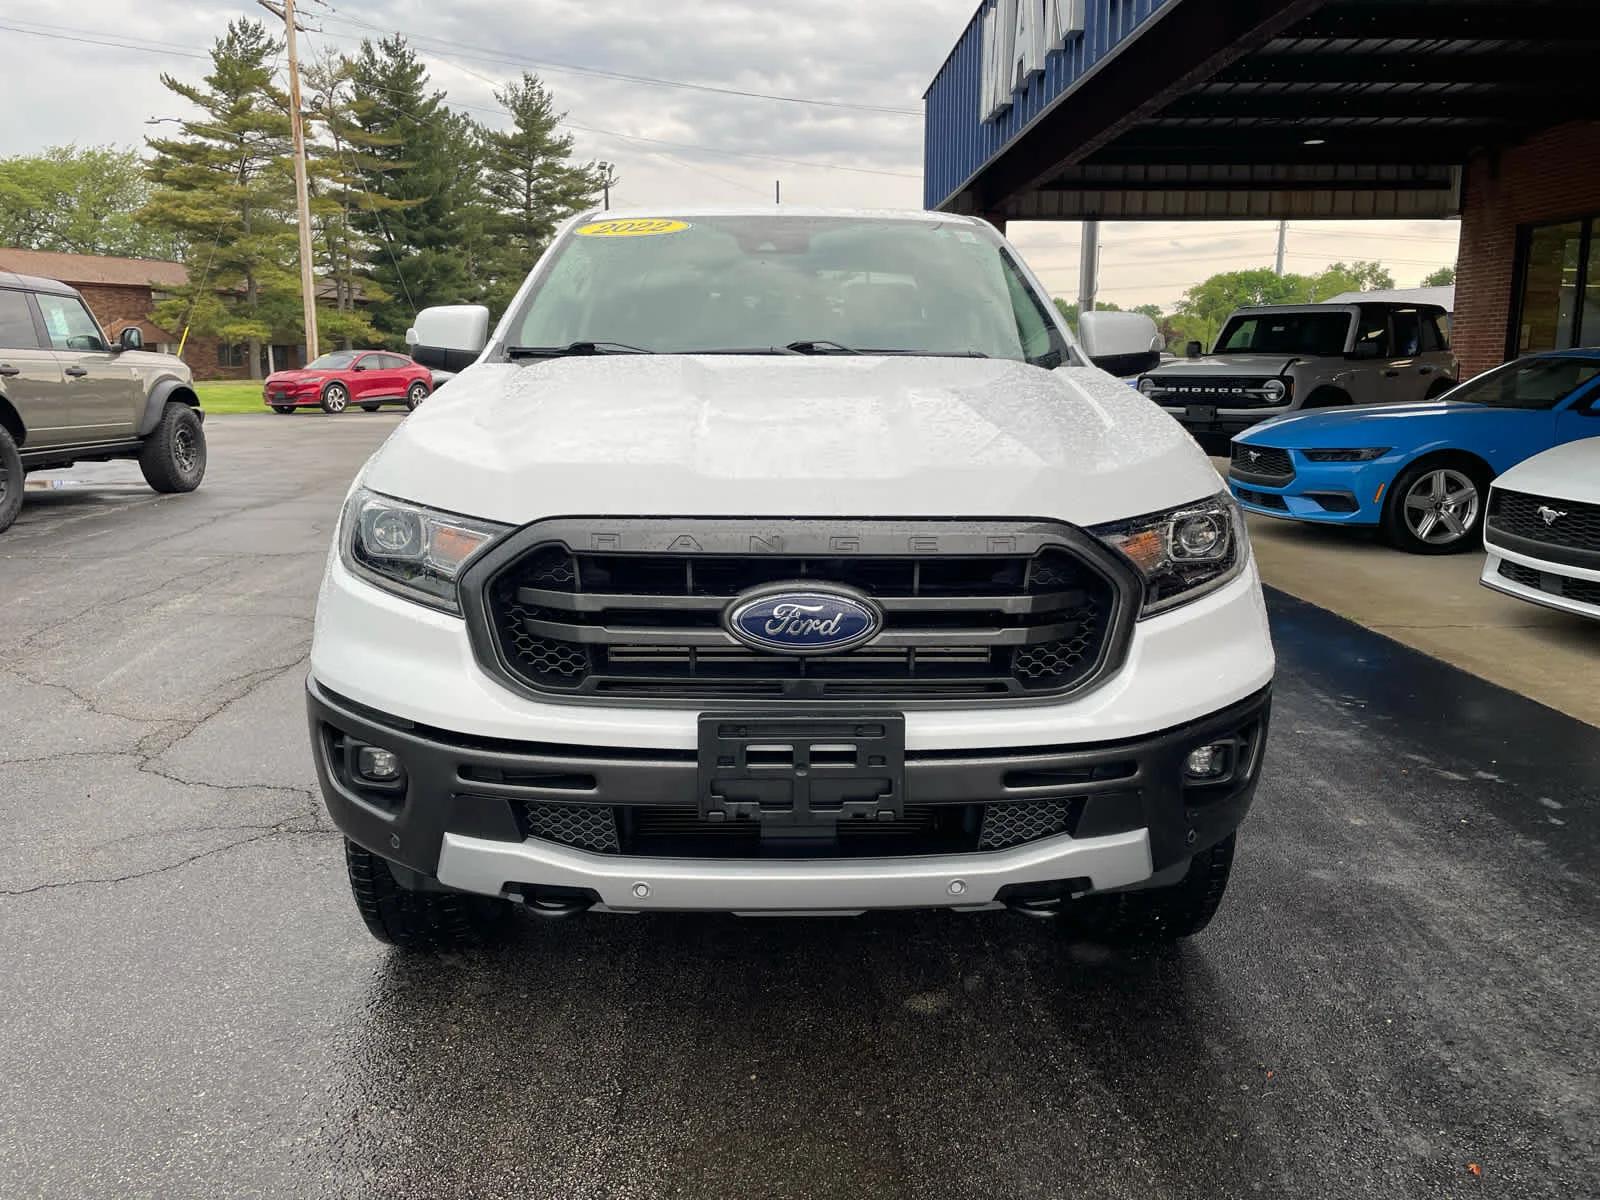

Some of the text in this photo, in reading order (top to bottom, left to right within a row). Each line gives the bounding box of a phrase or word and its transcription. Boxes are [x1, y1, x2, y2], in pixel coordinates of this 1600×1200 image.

[592, 221, 673, 234] 2022
[591, 533, 1017, 552] RANGER
[765, 603, 843, 635] Ford
